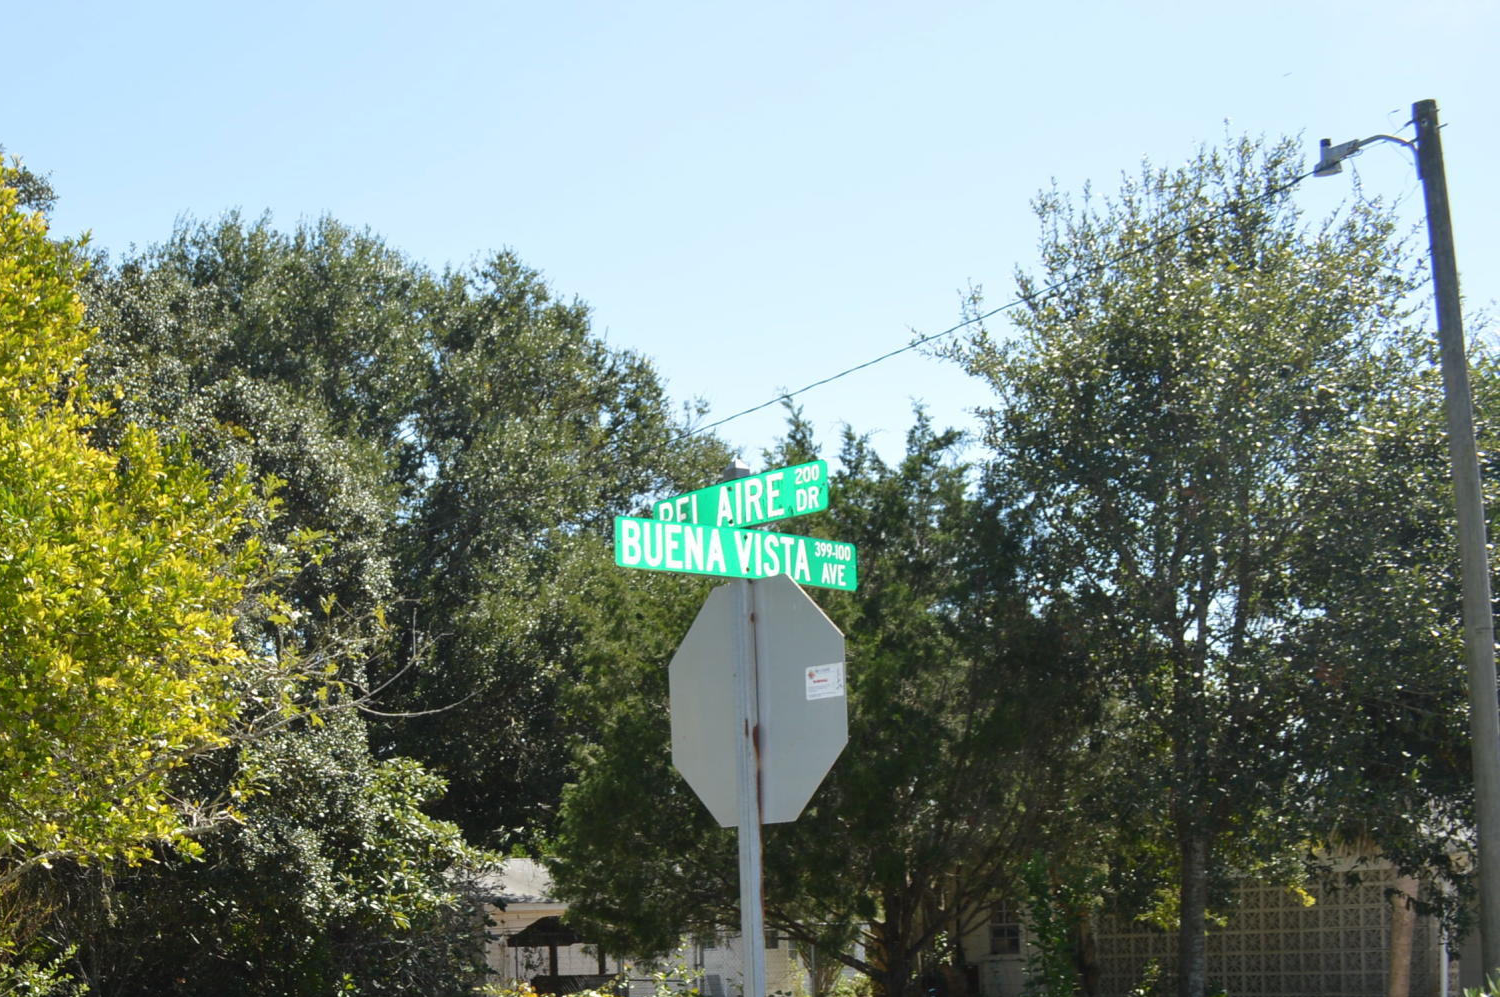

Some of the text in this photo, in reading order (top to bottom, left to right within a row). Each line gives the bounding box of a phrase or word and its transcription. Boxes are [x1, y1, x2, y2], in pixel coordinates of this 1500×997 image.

[794, 464, 819, 485] 200
[716, 473, 784, 527] AIRE
[796, 486, 819, 512] DR
[621, 518, 812, 582] BUENA VISTA
[815, 541, 851, 561] 399-100
[821, 563, 847, 587] AVE
